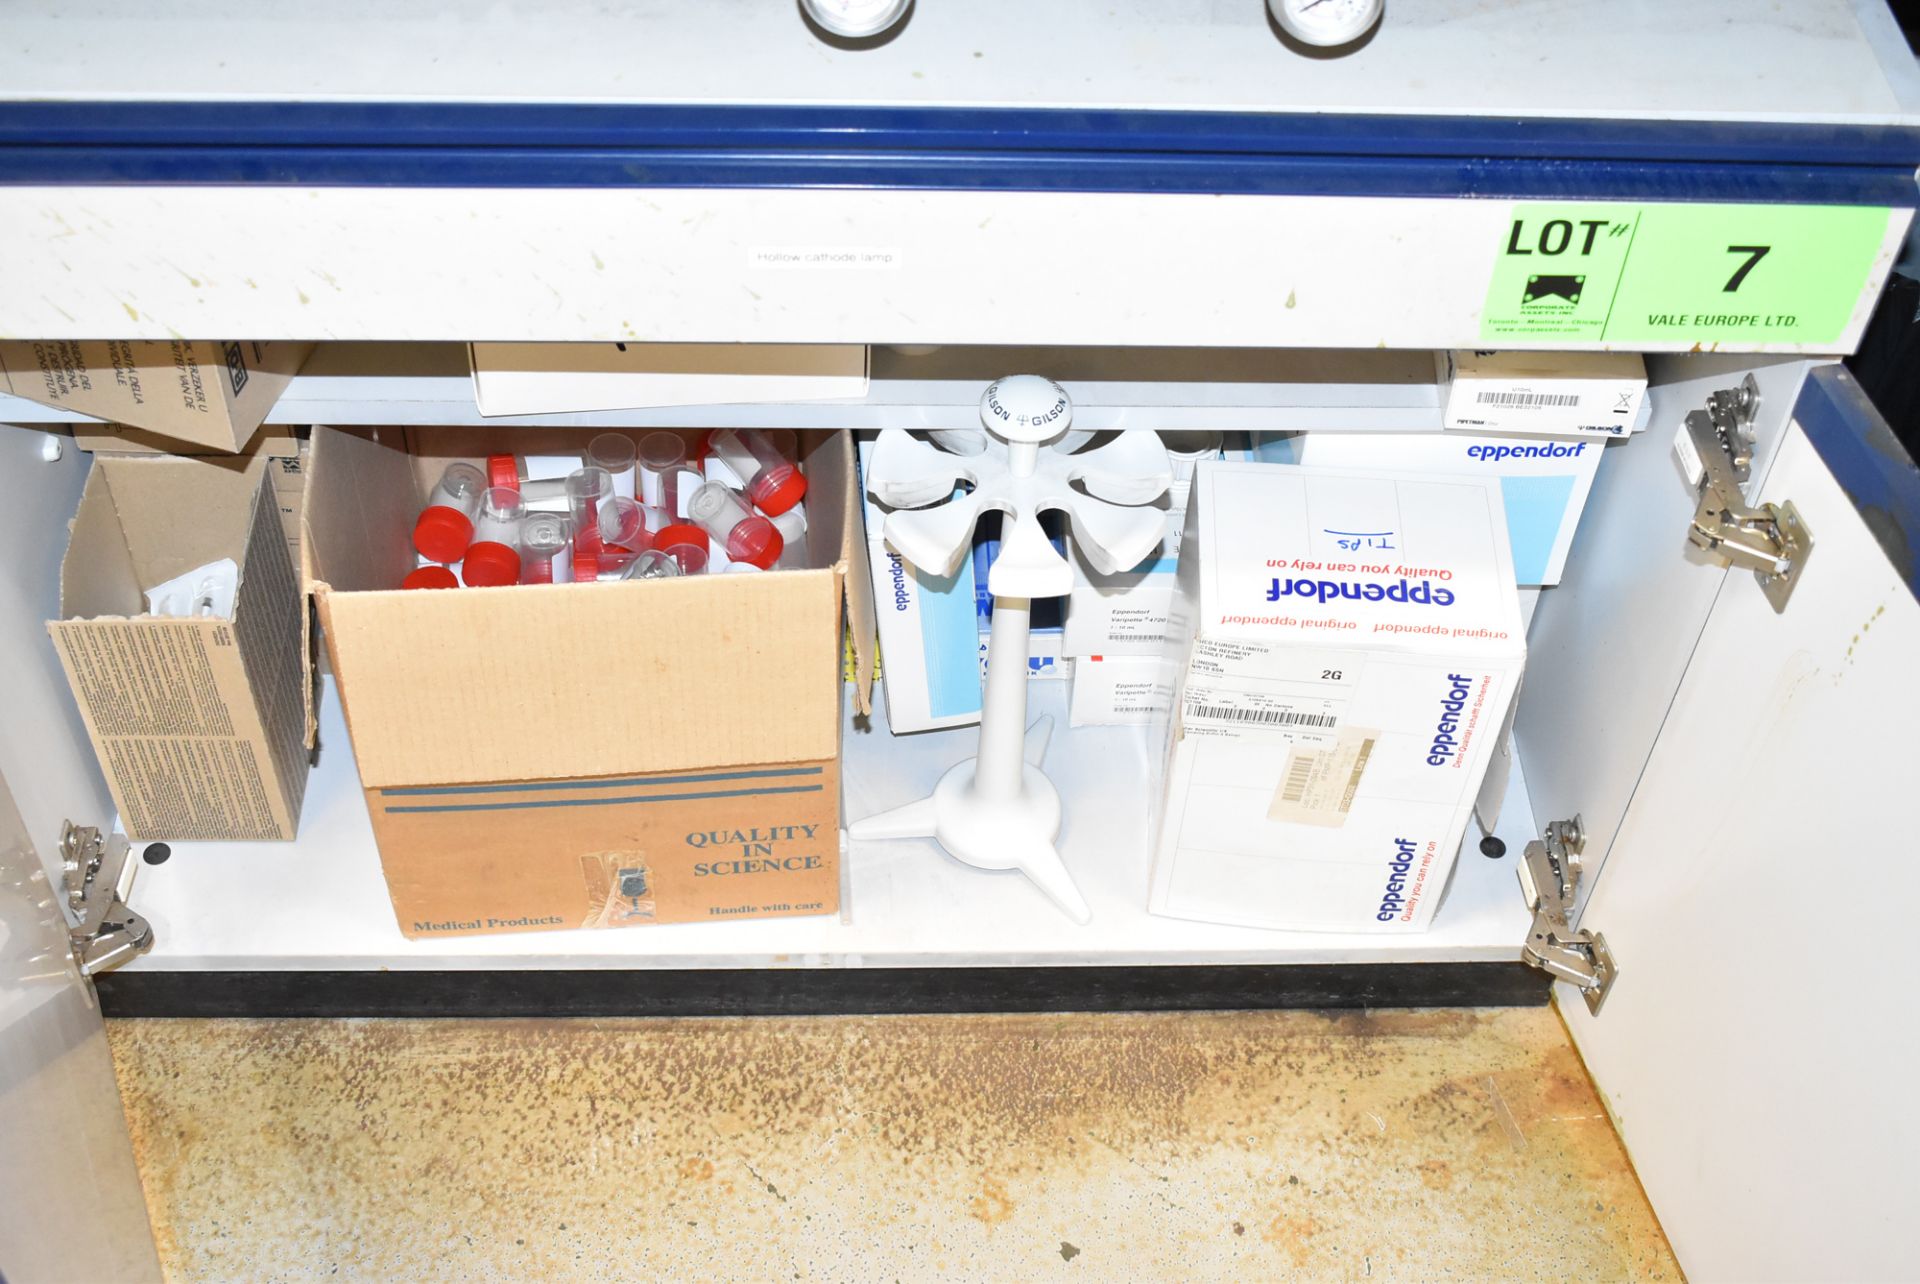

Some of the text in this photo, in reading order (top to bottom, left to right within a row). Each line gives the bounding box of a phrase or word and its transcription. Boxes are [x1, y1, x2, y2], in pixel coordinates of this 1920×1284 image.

[758, 253, 893, 263] Hollow cathode lamp
[1722, 246, 1771, 292] 7
[1648, 314, 1800, 327] VALE EUROPE LTD.
[988, 386, 1011, 420] GILSON
[1031, 397, 1067, 426] GILSON
[1467, 442, 1587, 461] eppendorf
[1266, 559, 1453, 580] Quality you can rely on
[886, 552, 911, 611] eppendorf
[1266, 577, 1455, 606] eppendorf
[1221, 615, 1357, 630] original eppendorf
[1373, 623, 1508, 640] original eppendorf
[1214, 641, 1241, 649] EUROPE
[1192, 659, 1219, 667] LONDON
[1321, 670, 1343, 680] 2G
[1426, 673, 1473, 766] eppendorf
[1452, 752, 1465, 768] Denn
[686, 824, 819, 848] QUALITY
[743, 842, 773, 857] IN
[694, 855, 824, 876] SCIENCE
[1376, 837, 1418, 921] eppendorf
[1400, 841, 1437, 921] Quality you can rely on
[709, 902, 824, 915] Handle with care
[414, 915, 564, 931] Medical Products
